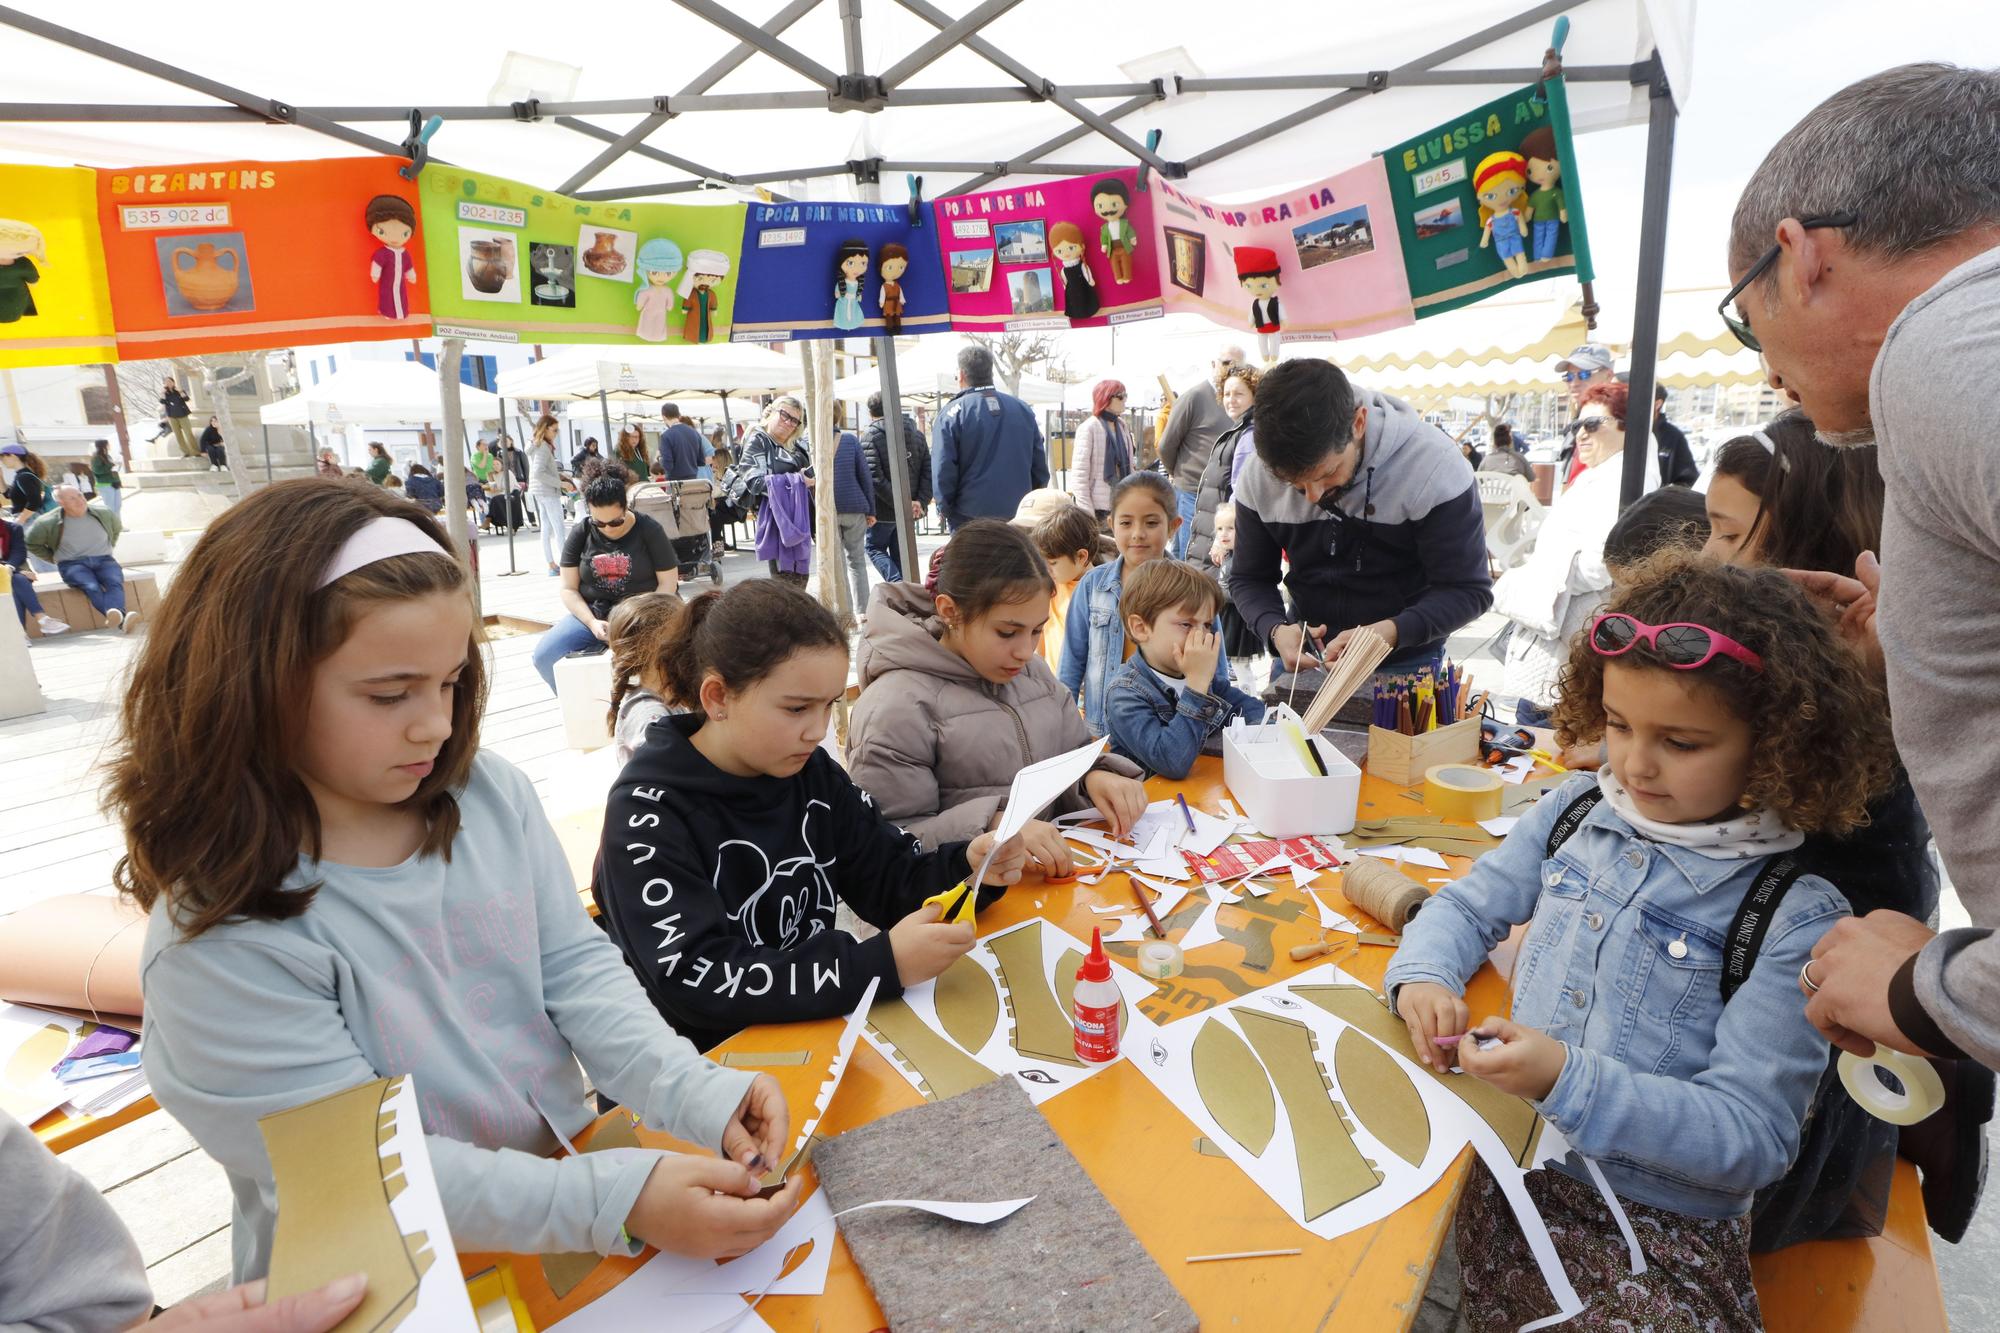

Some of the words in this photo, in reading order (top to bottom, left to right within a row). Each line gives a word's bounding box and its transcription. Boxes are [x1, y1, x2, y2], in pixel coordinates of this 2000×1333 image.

[1402, 113, 1502, 172] EIVISSA
[111, 170, 276, 194] BIZANTINS
[461, 205, 524, 225] 902-1235
[755, 205, 800, 223] EPOCA
[805, 205, 833, 222] BAIX
[837, 206, 901, 224] MEDIEVAL
[980, 190, 1046, 214] MODERNA
[1567, 797, 1596, 823] MINNIE
[1550, 820, 1572, 849] MOUSE
[626, 786, 686, 950] MOUSE
[1752, 875, 1781, 905] MOUSE
[1736, 909, 1761, 945] MINNIE
[1728, 943, 1748, 977] MOUSE
[657, 951, 842, 999] MICKEY
